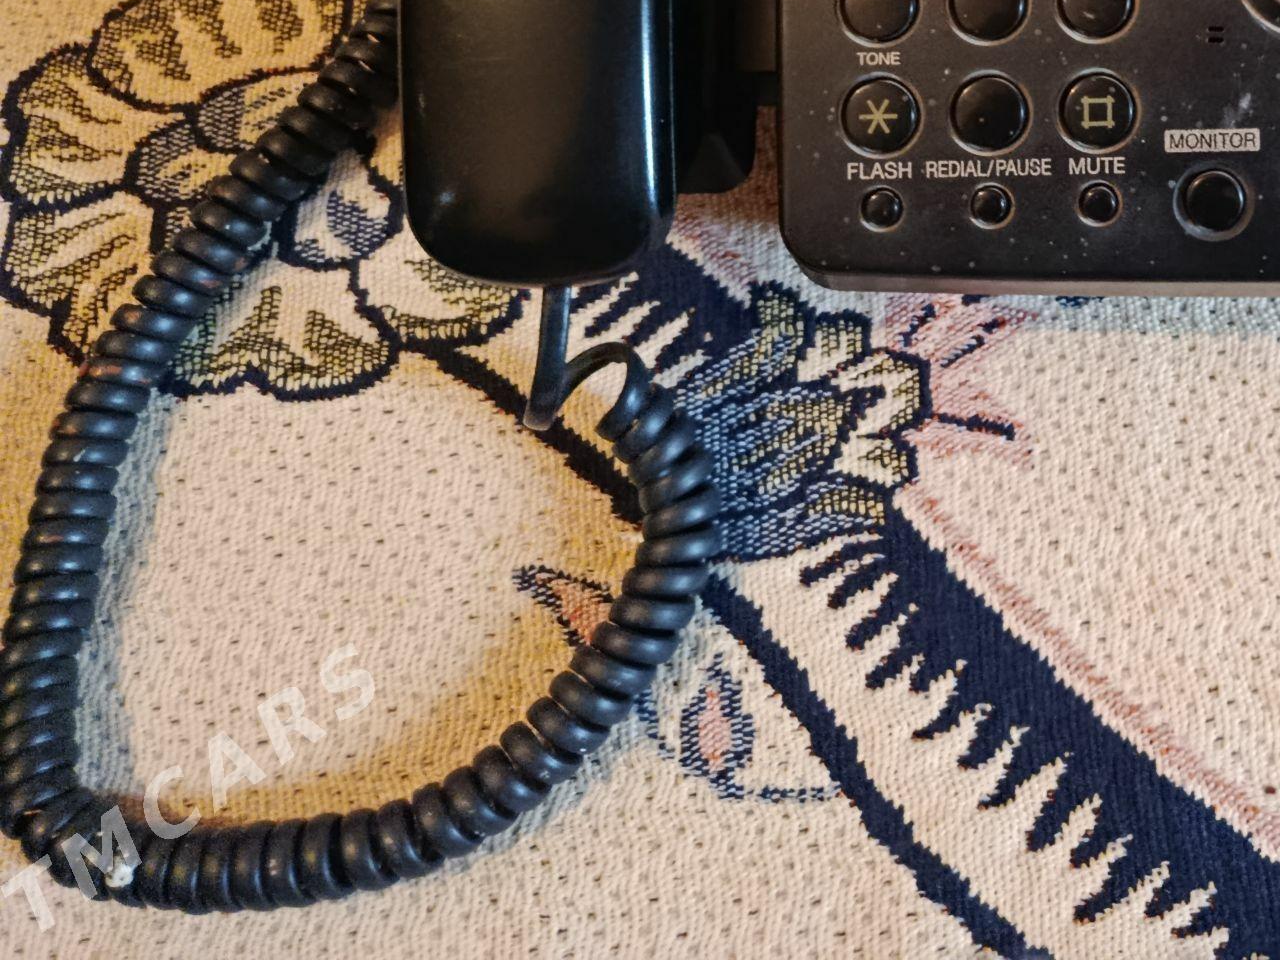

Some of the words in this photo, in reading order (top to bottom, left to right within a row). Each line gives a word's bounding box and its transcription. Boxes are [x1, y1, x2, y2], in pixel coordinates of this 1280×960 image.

[856, 51, 902, 66] TONE
[1168, 131, 1258, 151] MONITOR
[847, 162, 913, 181] FLASH
[925, 159, 1052, 178] REDIAL/PAUSE
[1068, 156, 1127, 176] MUTE
